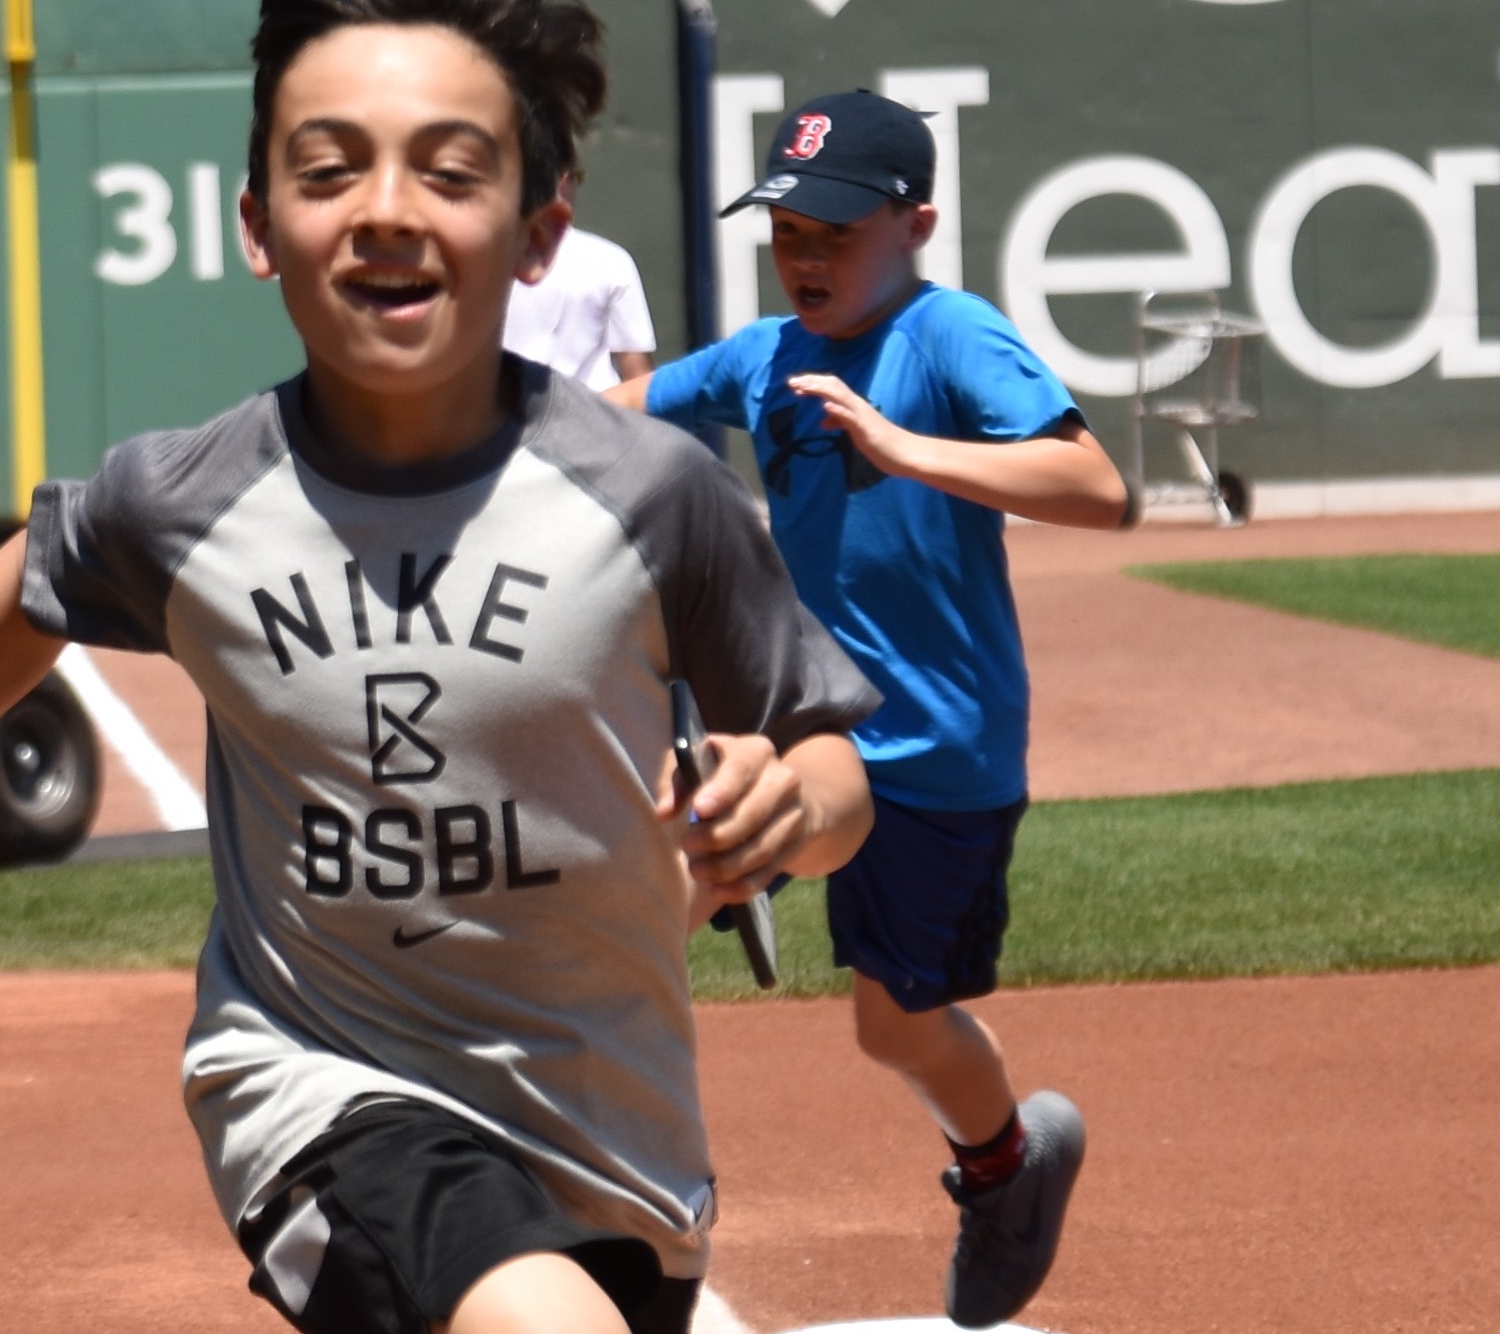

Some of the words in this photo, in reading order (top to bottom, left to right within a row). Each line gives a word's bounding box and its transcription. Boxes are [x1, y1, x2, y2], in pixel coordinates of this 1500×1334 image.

[783, 111, 832, 161] B
[94, 162, 240, 287] 31
[248, 550, 552, 678] NIKE
[301, 796, 563, 903] BSBL
